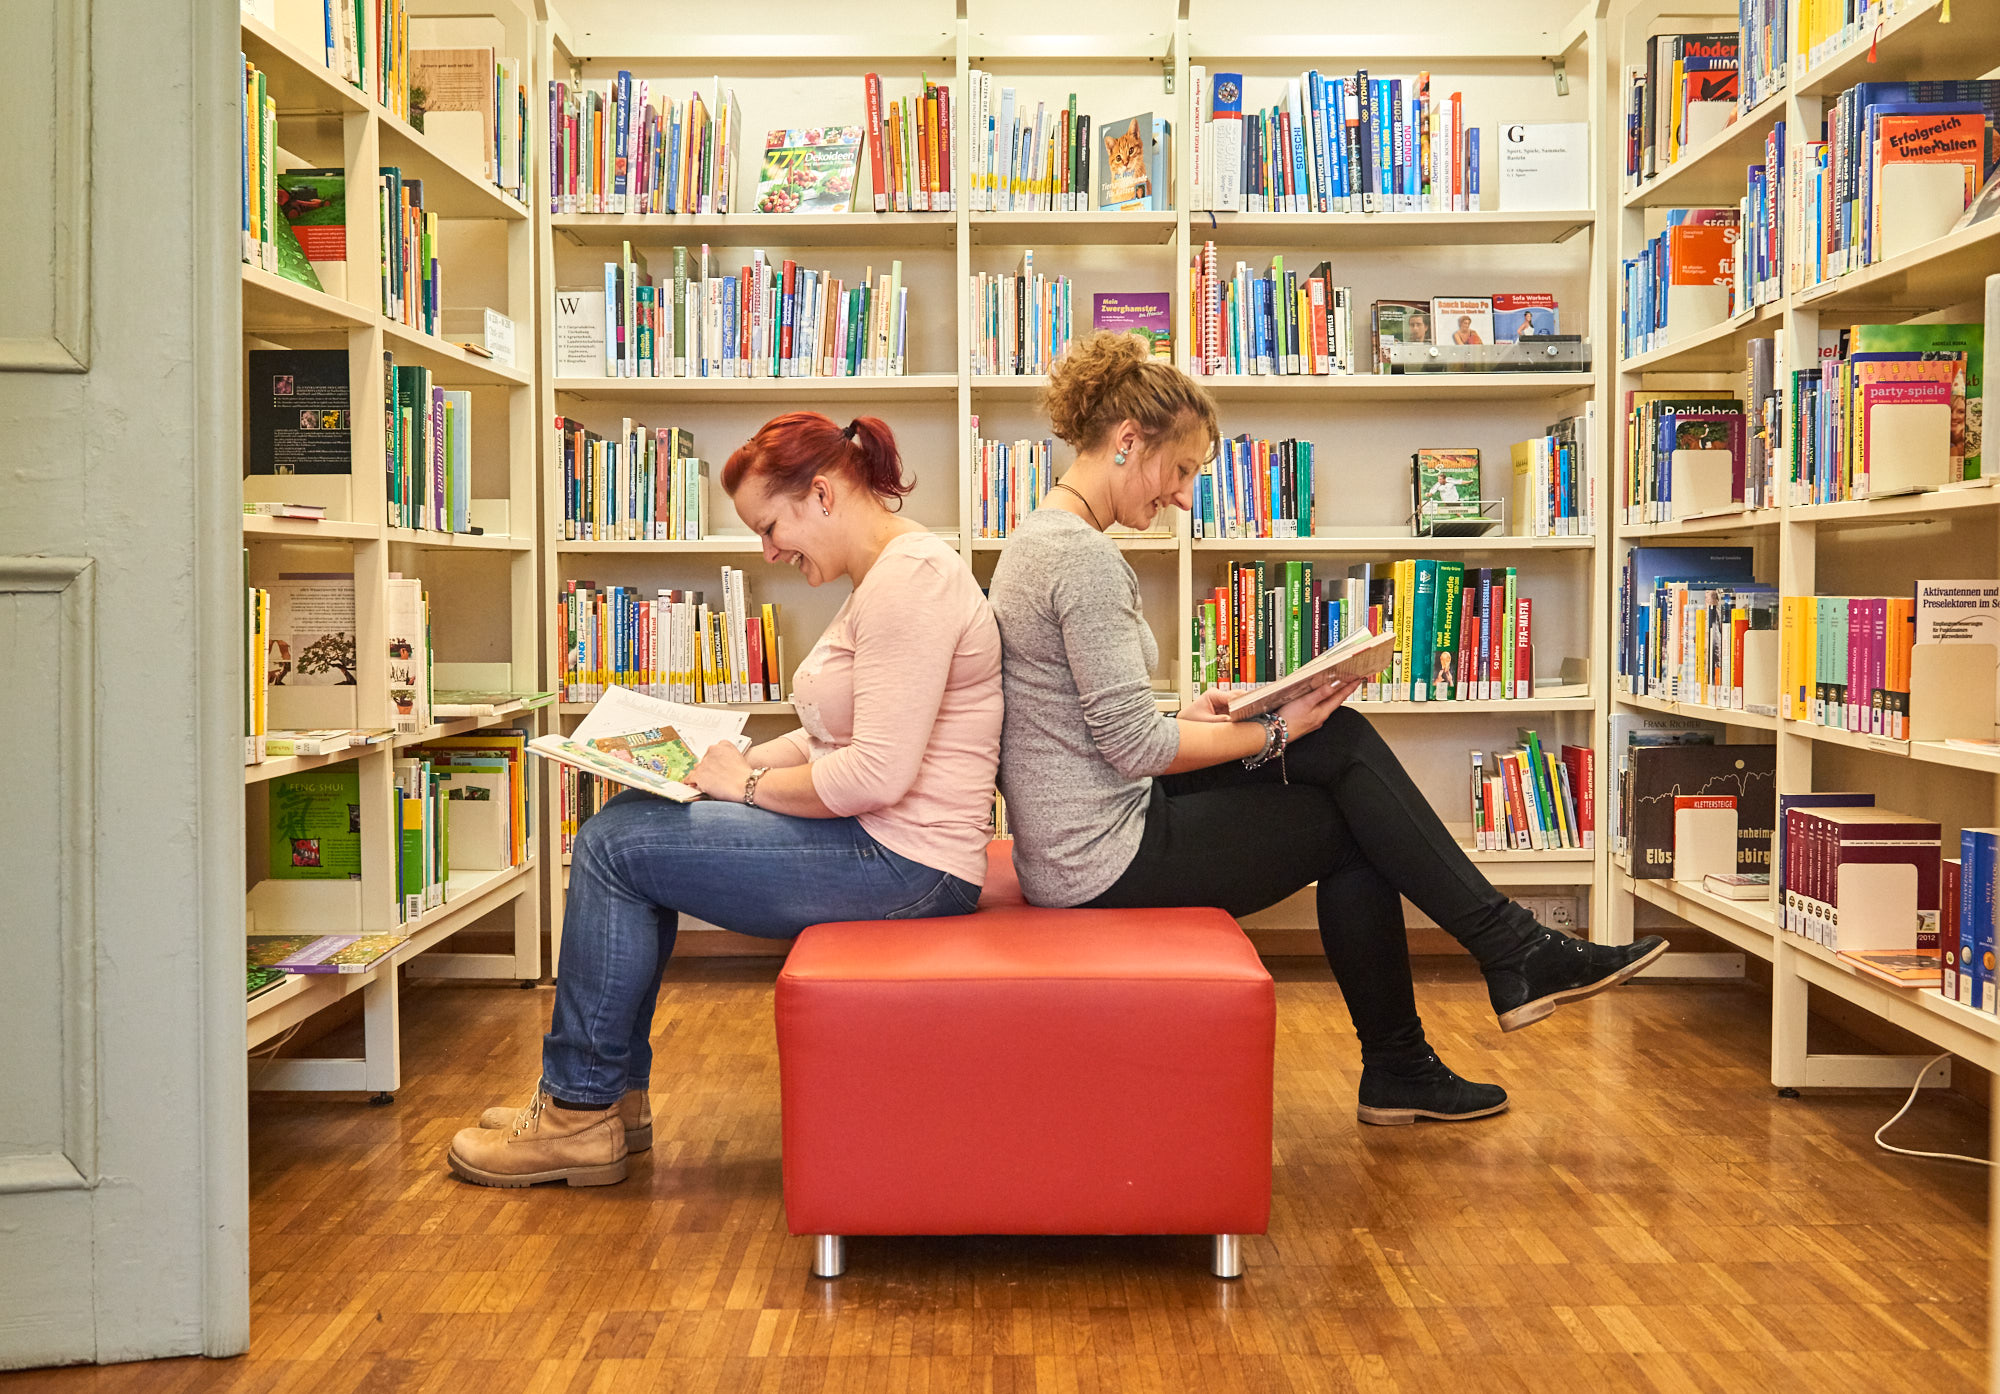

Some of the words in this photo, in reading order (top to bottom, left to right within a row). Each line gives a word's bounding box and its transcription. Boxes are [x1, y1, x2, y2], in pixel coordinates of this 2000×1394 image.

[870, 78, 879, 94] Stadt
[1360, 73, 1368, 106] SYDNEY
[1370, 98, 1378, 116] 2002
[1393, 100, 1403, 121] 2010
[1507, 125, 1525, 143] G
[1889, 116, 1962, 148] Erfolgreich
[1293, 127, 1303, 170] SOTSCHI
[1393, 121, 1403, 166] VANCOUVER
[1404, 125, 1412, 168] LONDON
[767, 150, 807, 168] 777
[805, 152, 854, 162] Dekoideen
[1768, 142, 1776, 230] LOIPENATLAS
[559, 297, 580, 315] W
[1101, 305, 1157, 314] Zwerghamster
[1870, 385, 1946, 398] party-spiele
[1482, 579, 1490, 608] FUSSBALLS
[1923, 587, 1981, 597] Aktivantennen
[1983, 587, 1999, 597] und
[1443, 576, 1455, 647] WM-Enzyklopädie
[1923, 599, 1977, 608] Preselektoren
[1979, 599, 1990, 608] im
[1482, 608, 1490, 618] DES
[1519, 602, 1529, 648] FIFA-MAFIA
[1494, 662, 1500, 670] 50
[1643, 720, 1668, 728] FRANK
[289, 783, 316, 792] FENG
[319, 783, 344, 791] SHUI
[1526, 791, 1534, 808] Lauf
[1693, 800, 1733, 809] KLETTERSTEIGE
[1646, 848, 1673, 864] Elbs
